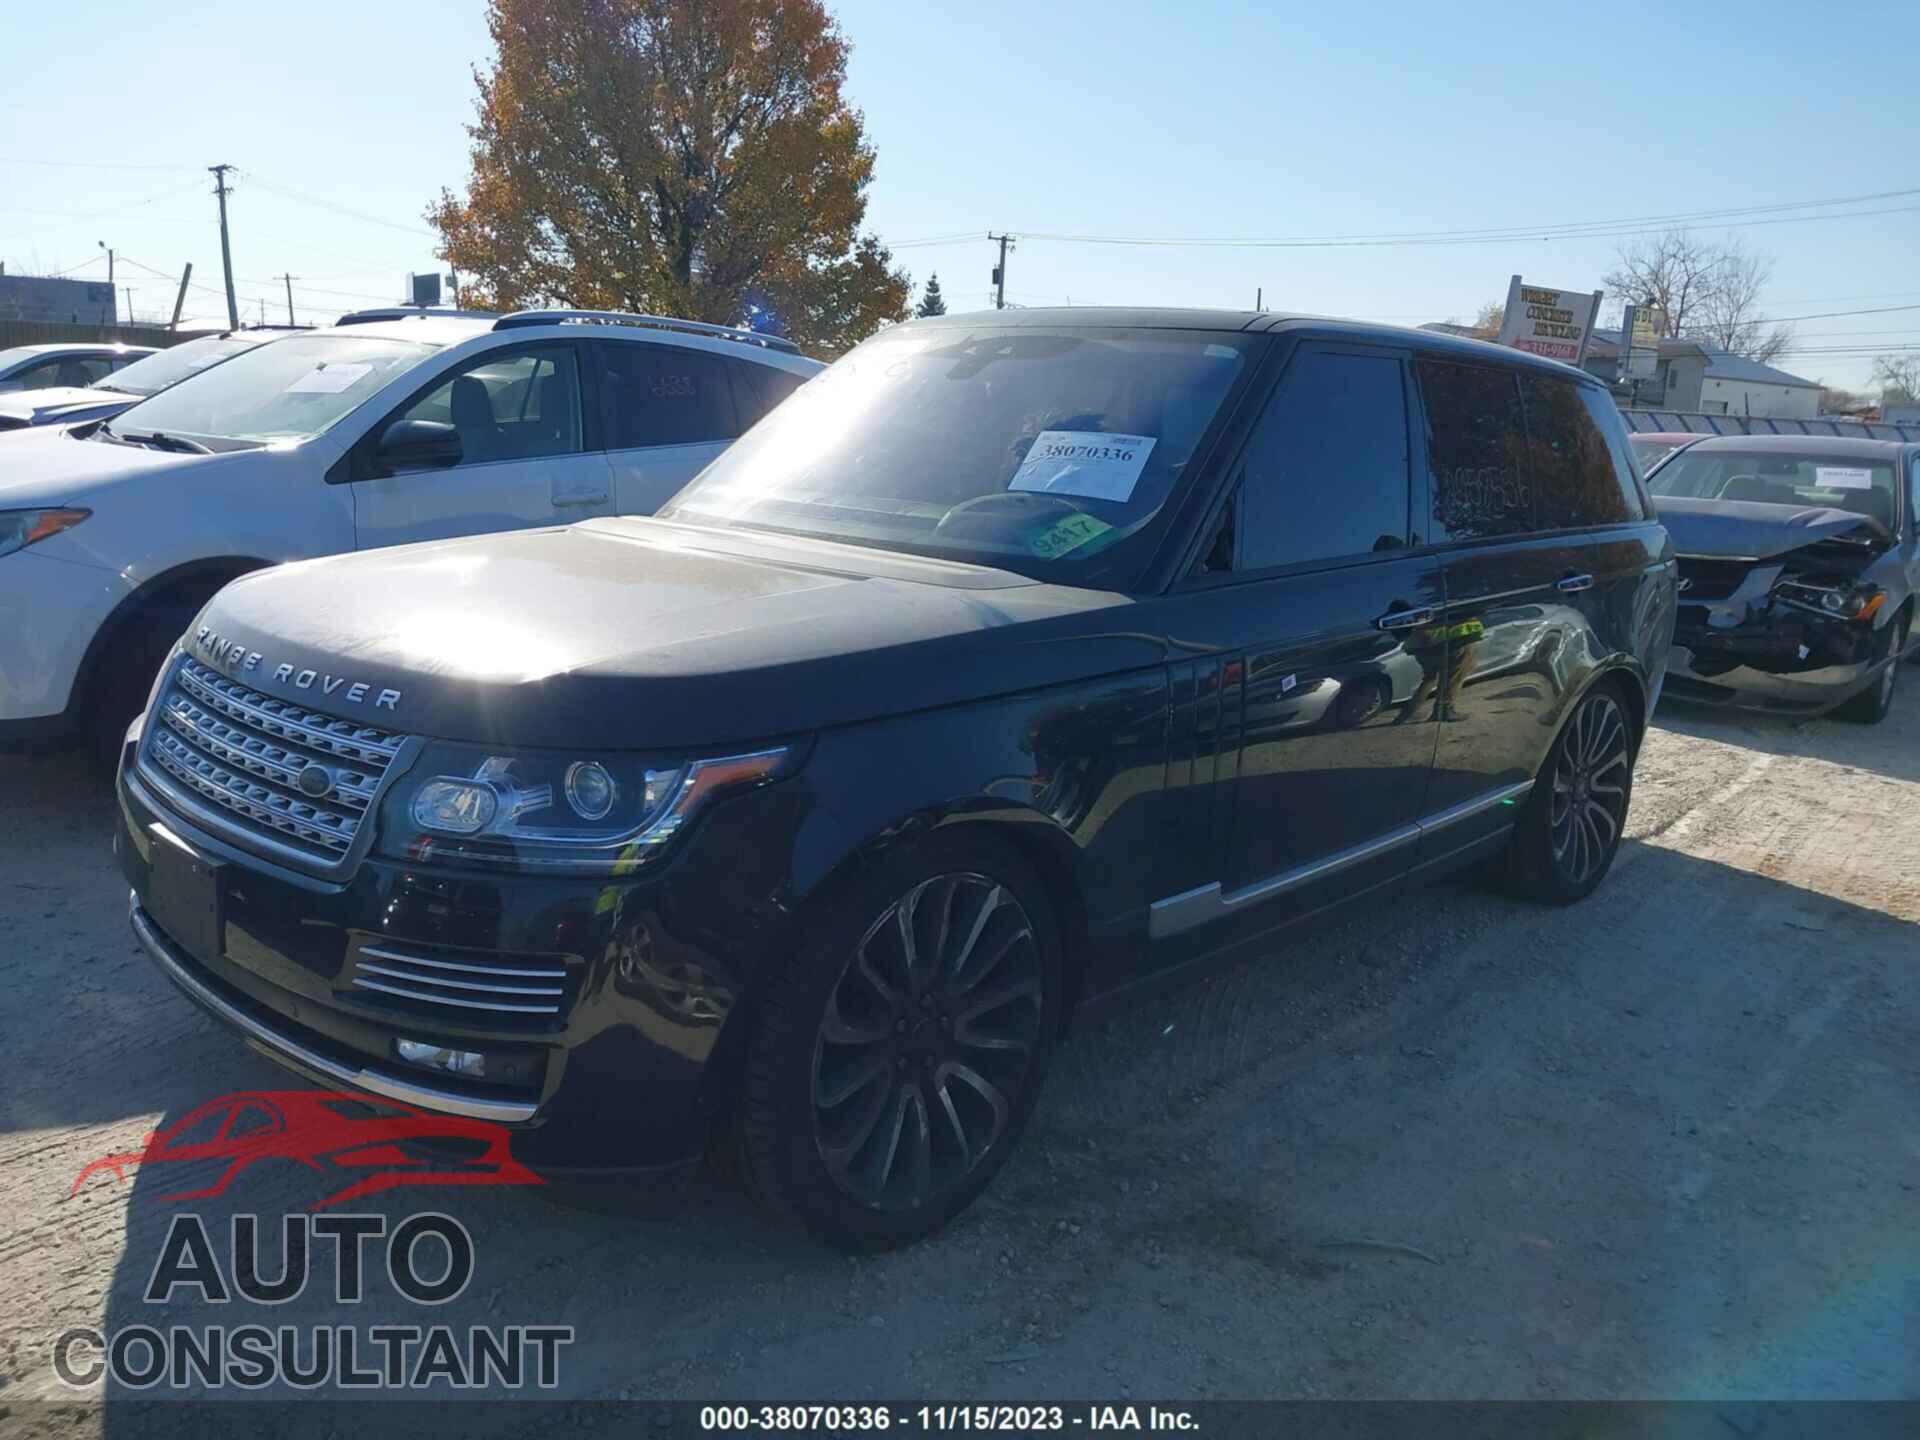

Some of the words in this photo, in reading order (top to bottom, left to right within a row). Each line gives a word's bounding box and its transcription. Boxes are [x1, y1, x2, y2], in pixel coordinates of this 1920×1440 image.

[1040, 444, 1136, 461] 38070336
[197, 626, 262, 671] RANGE
[273, 662, 401, 711] ROVER
